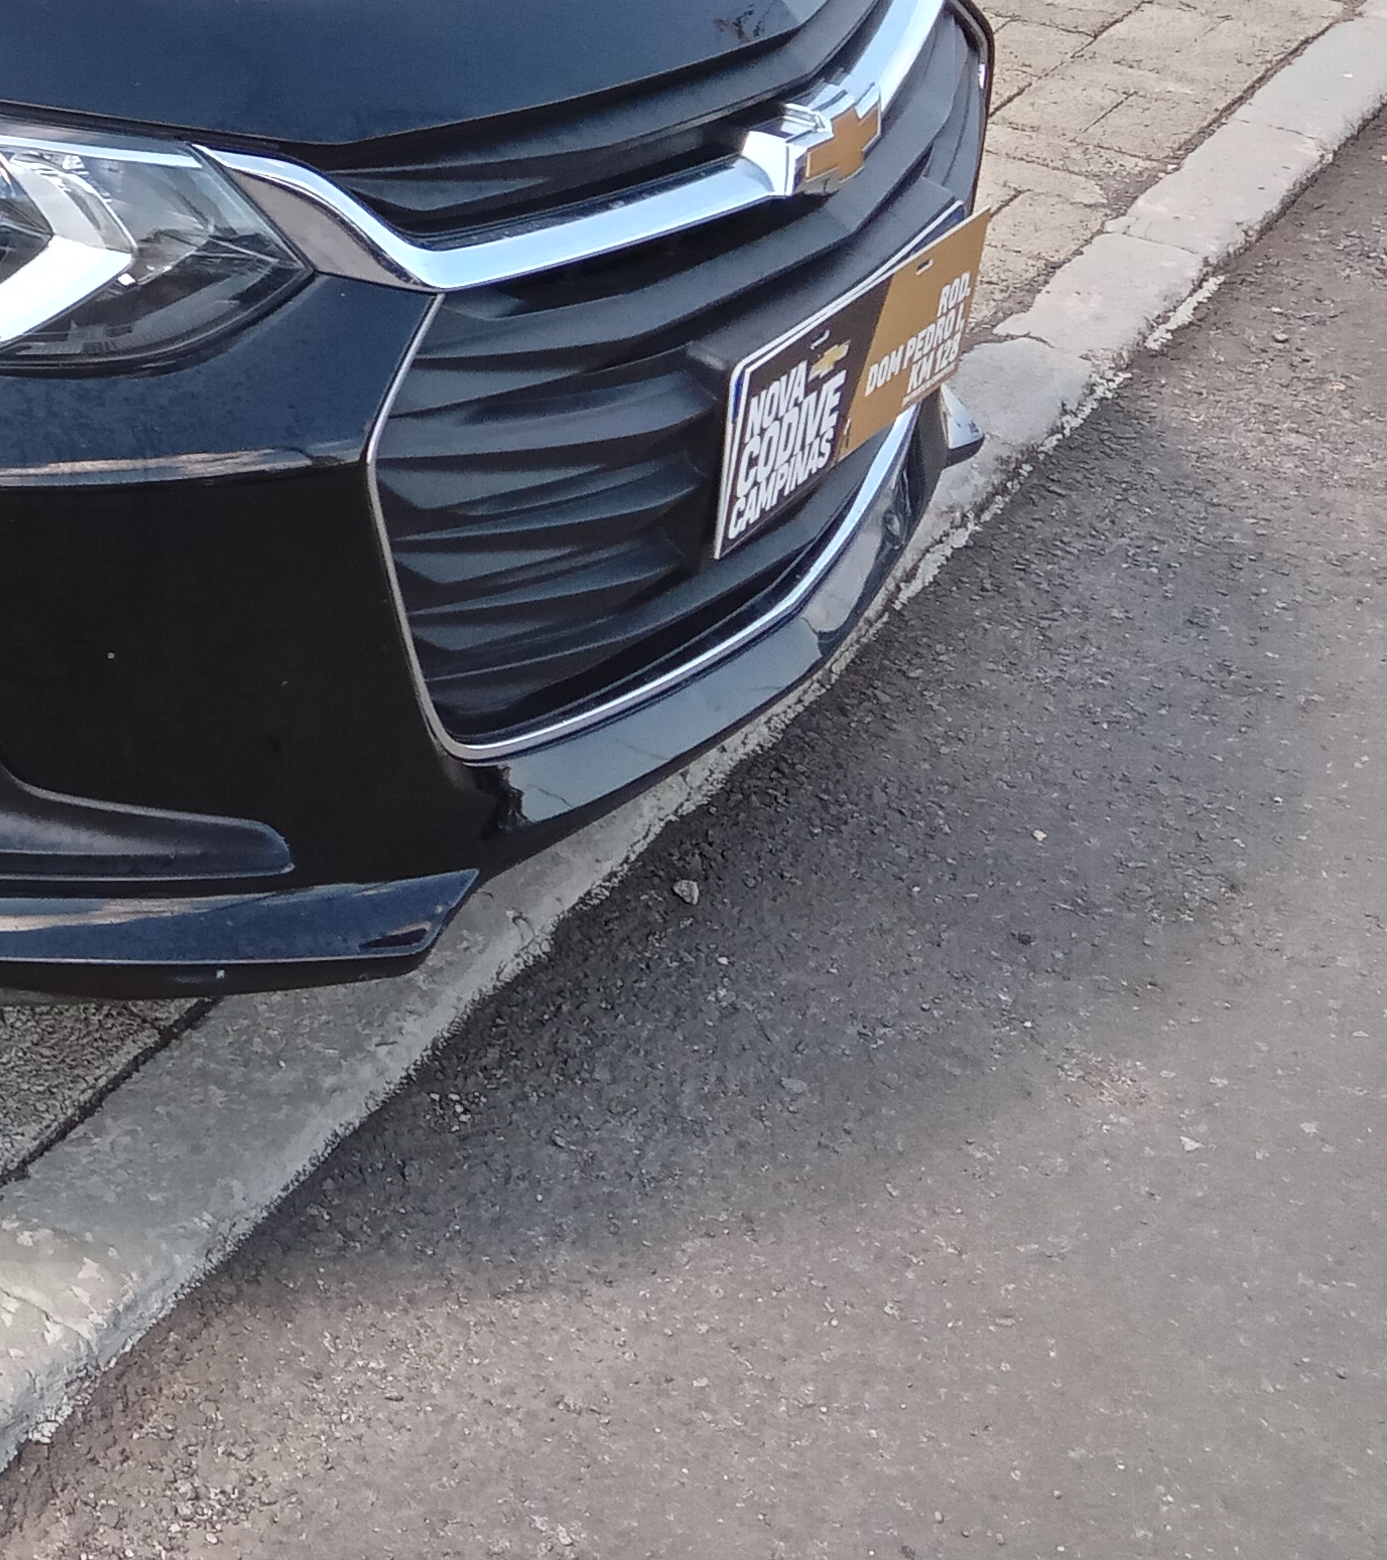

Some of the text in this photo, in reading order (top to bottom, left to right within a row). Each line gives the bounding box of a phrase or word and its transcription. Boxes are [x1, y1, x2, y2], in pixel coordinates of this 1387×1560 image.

[936, 271, 972, 317] ROD.
[864, 344, 905, 397] DOM
[902, 308, 956, 370] PEDRO
[907, 351, 934, 394] KM
[934, 331, 962, 373] 128
[737, 370, 847, 498] CODIVE
[745, 360, 808, 443] NOVA
[728, 427, 835, 539] CAMPINAS
